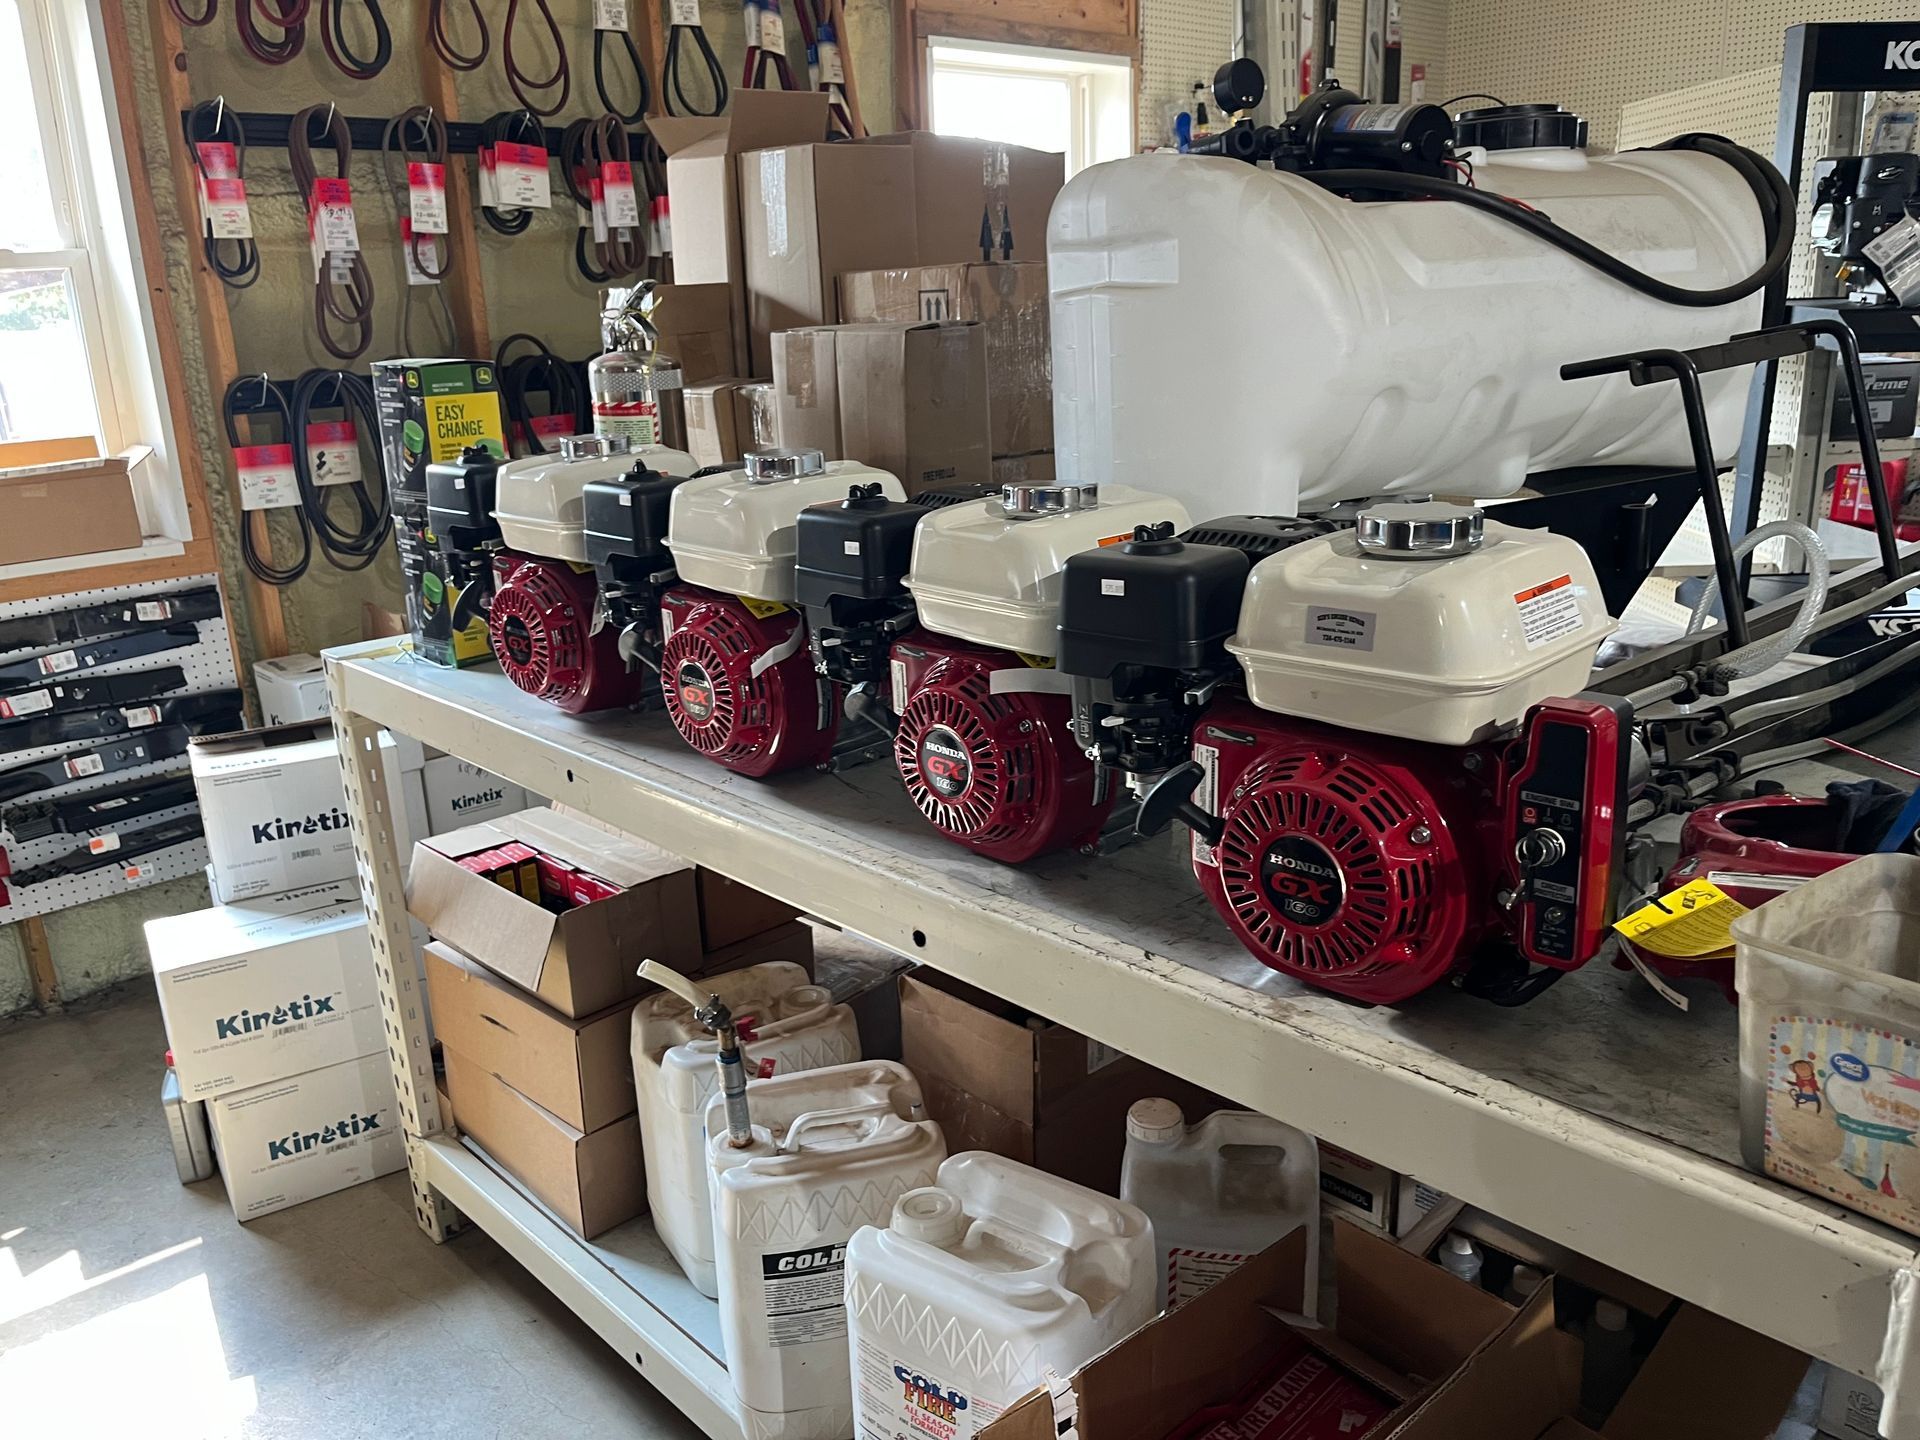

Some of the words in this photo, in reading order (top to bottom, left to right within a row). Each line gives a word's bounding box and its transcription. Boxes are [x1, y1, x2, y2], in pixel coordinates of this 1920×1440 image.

[436, 404, 465, 421] EASY
[438, 420, 484, 439] CHANGE
[682, 674, 711, 688] HONDA
[684, 686, 709, 706] GX
[926, 742, 967, 760] HONDA
[928, 756, 965, 780] GX
[452, 788, 503, 810] Kinetix
[1270, 853, 1337, 879] HONDA
[1271, 872, 1333, 904] GX
[1285, 898, 1320, 917] 160
[216, 994, 335, 1040] Kinetix
[268, 1114, 380, 1161] Kinetix
[778, 1247, 847, 1271] COLD
[894, 1360, 967, 1410] COLD
[904, 1380, 956, 1426] FIRE
[904, 1404, 918, 1418] ALL
[922, 1413, 957, 1436] SEASON
[910, 1414, 950, 1440] FORMULA
